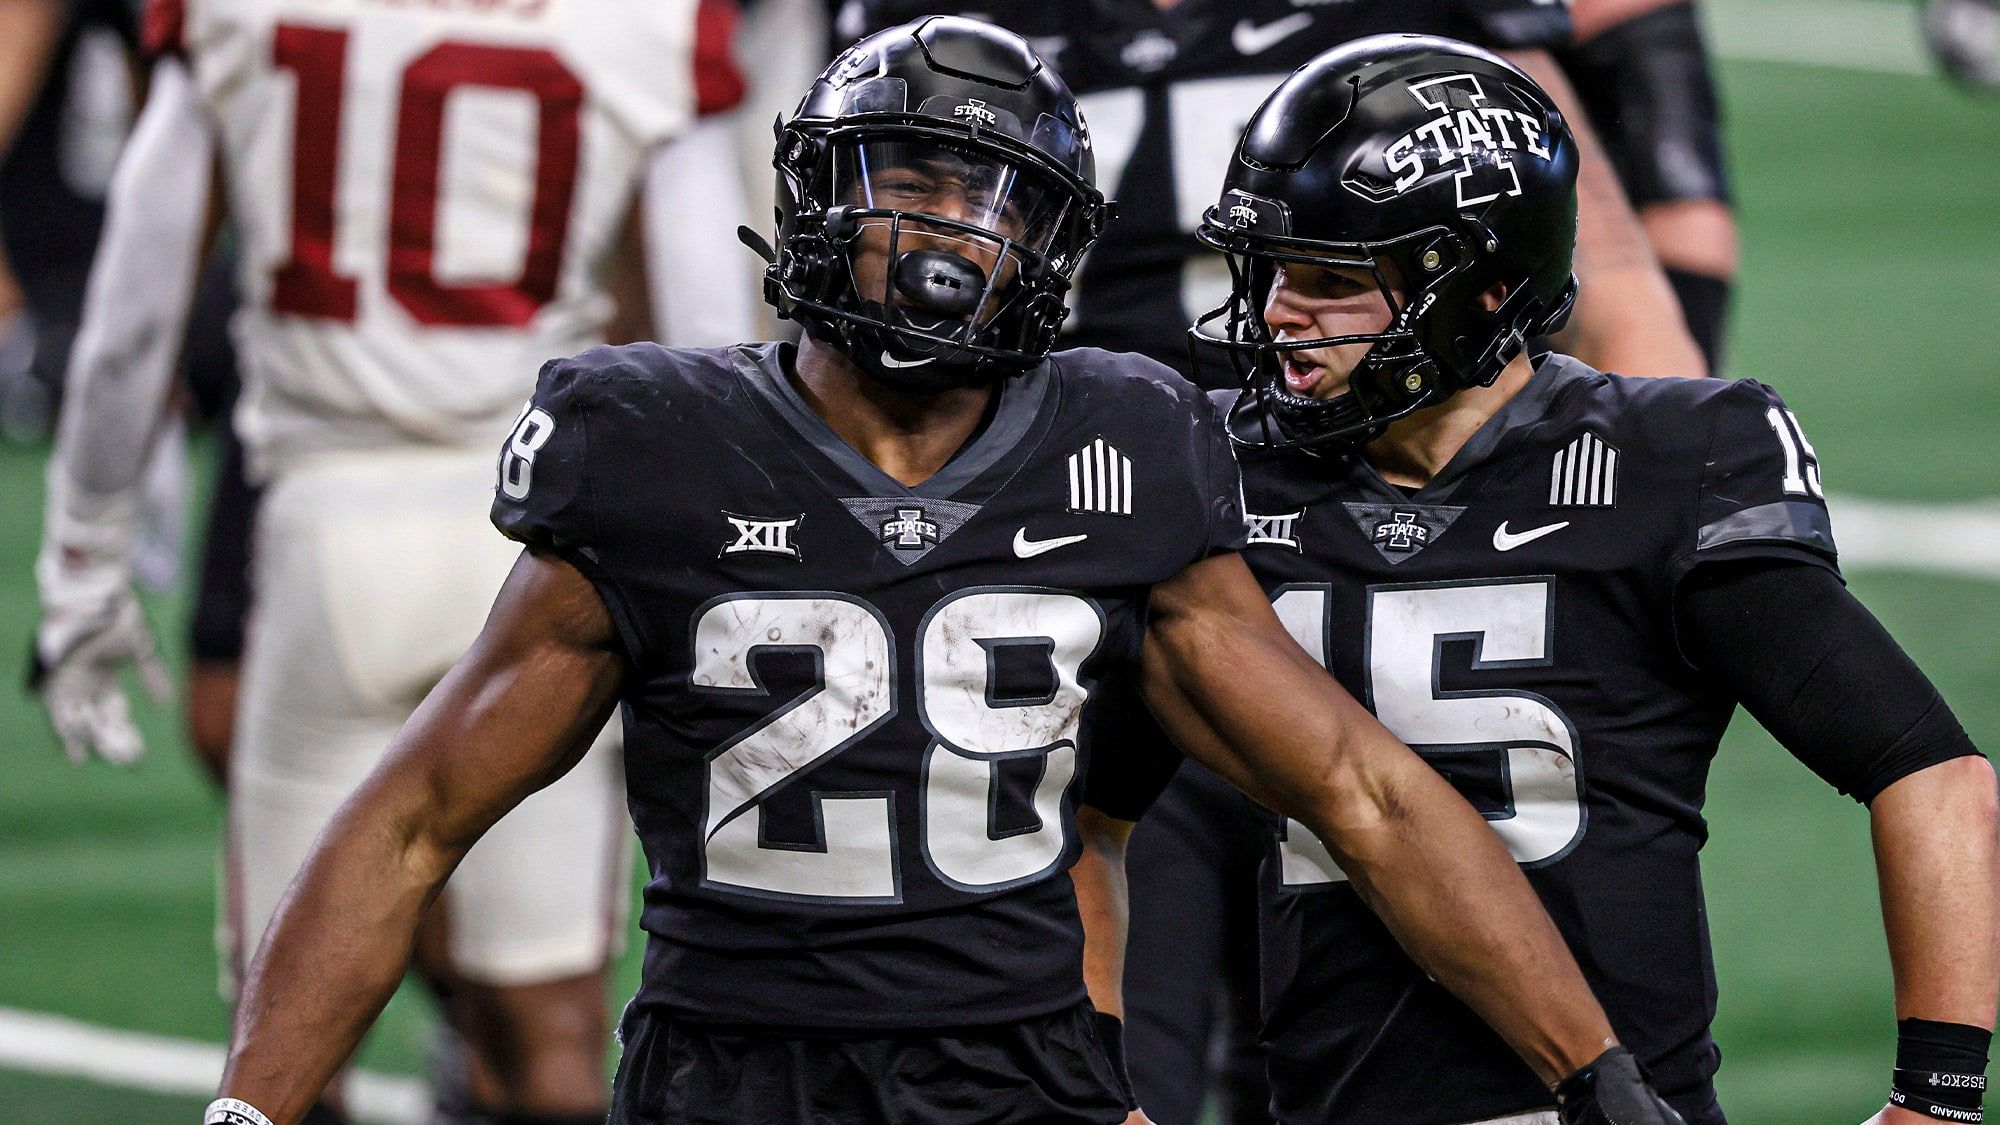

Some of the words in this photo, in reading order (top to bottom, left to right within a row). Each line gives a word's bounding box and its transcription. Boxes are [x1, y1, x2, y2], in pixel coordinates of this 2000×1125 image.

[954, 105, 995, 125] STATE
[1385, 108, 1552, 194] STATE
[273, 22, 585, 328] 10
[1230, 205, 1258, 225] STATE
[724, 516, 797, 556] XII
[883, 520, 938, 539] STATE
[1377, 523, 1428, 542] STATE
[689, 585, 1107, 903] 28
[1930, 1104, 1983, 1121] COMMAND
